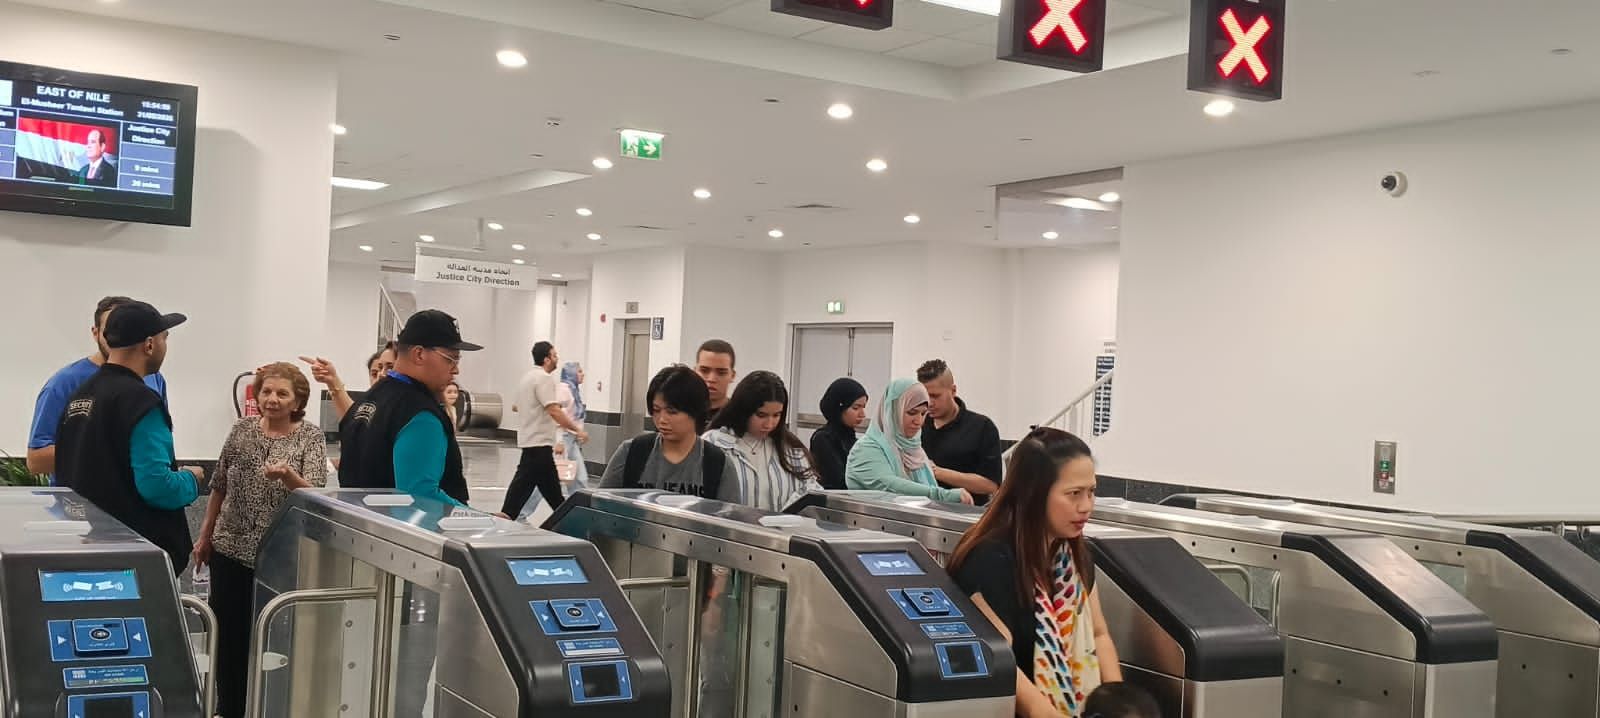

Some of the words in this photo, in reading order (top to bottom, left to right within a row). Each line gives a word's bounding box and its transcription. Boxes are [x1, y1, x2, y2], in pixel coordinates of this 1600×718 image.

[36, 85, 66, 97] EAST
[68, 89, 84, 99] OF
[85, 91, 111, 103] NILE
[436, 271, 465, 281] Justice
[467, 274, 482, 284] City
[484, 276, 520, 286] Direction
